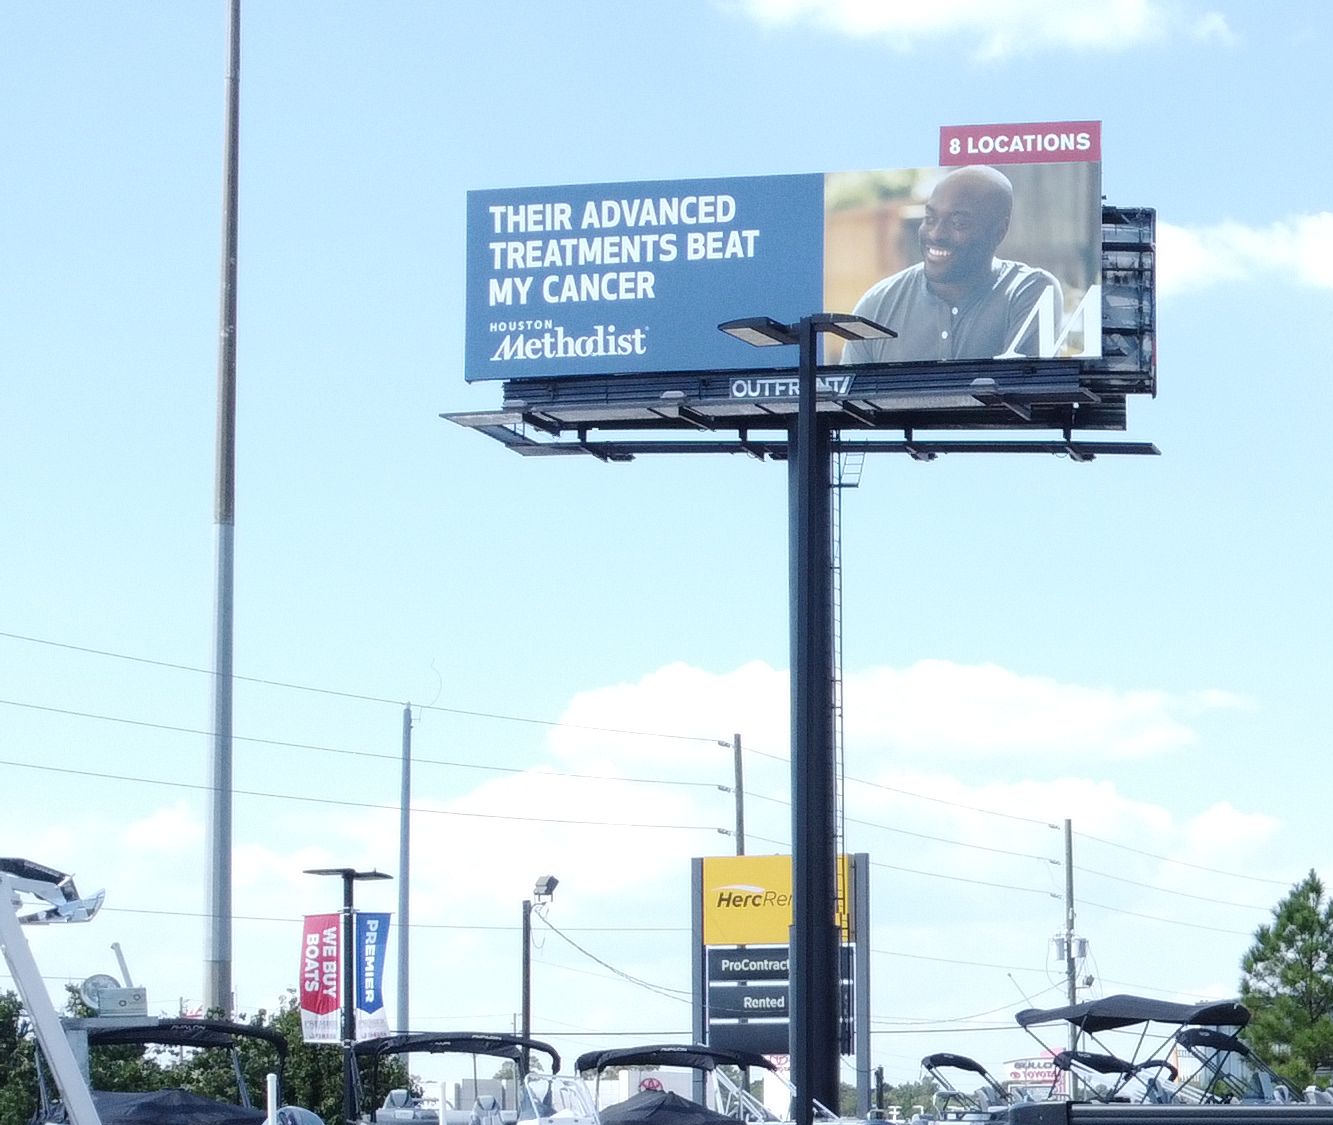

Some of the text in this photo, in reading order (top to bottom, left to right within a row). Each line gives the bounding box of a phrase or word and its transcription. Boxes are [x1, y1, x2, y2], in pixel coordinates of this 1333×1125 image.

[949, 132, 1091, 155] 8 LOCATIONS
[489, 195, 737, 233] THEIR ADVANCED
[489, 230, 760, 270] TREATMENTS BEAT
[489, 271, 656, 306] MY CANCER
[490, 319, 553, 333] HOUSTON
[490, 324, 647, 362] Methodist
[305, 933, 320, 993] BOATS
[322, 926, 337, 999] WE BUY
[364, 919, 379, 1003] PREMIER
[743, 996, 785, 1009] Rented
